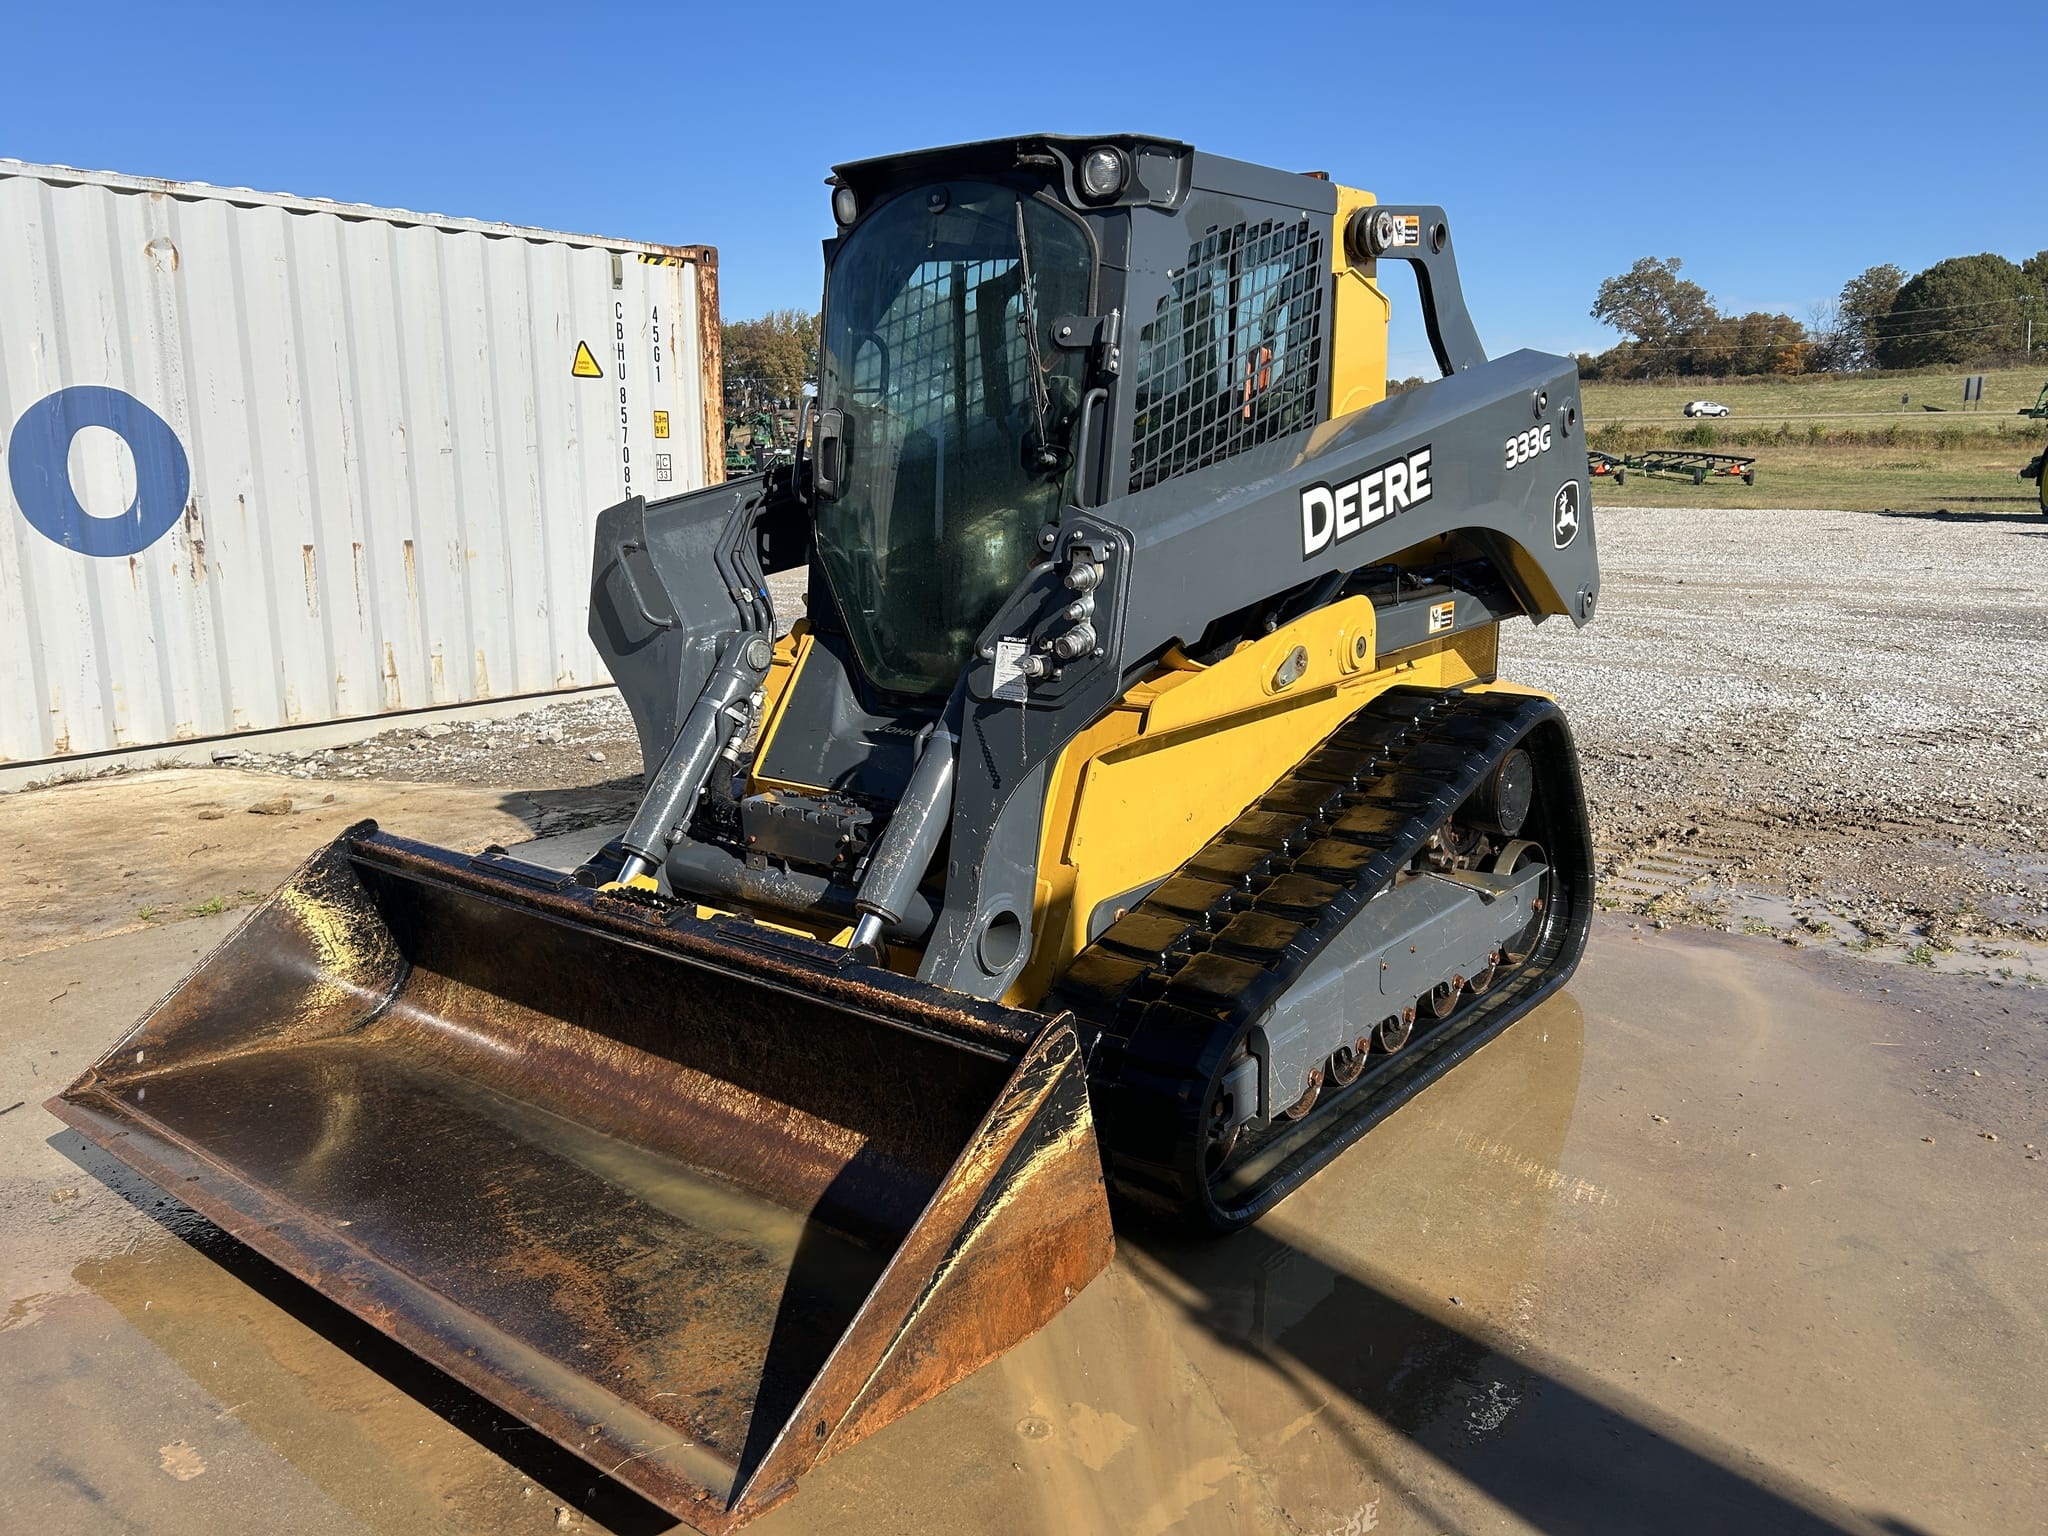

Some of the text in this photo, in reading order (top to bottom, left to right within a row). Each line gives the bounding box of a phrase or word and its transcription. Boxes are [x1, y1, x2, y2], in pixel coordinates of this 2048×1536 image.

[615, 301, 626, 380] CBHU
[652, 305, 661, 382] 45G1
[658, 470, 668, 479] 33
[1505, 423, 1551, 470] 333G
[1301, 445, 1432, 558] DEERE
[876, 724, 919, 737] JOHN
